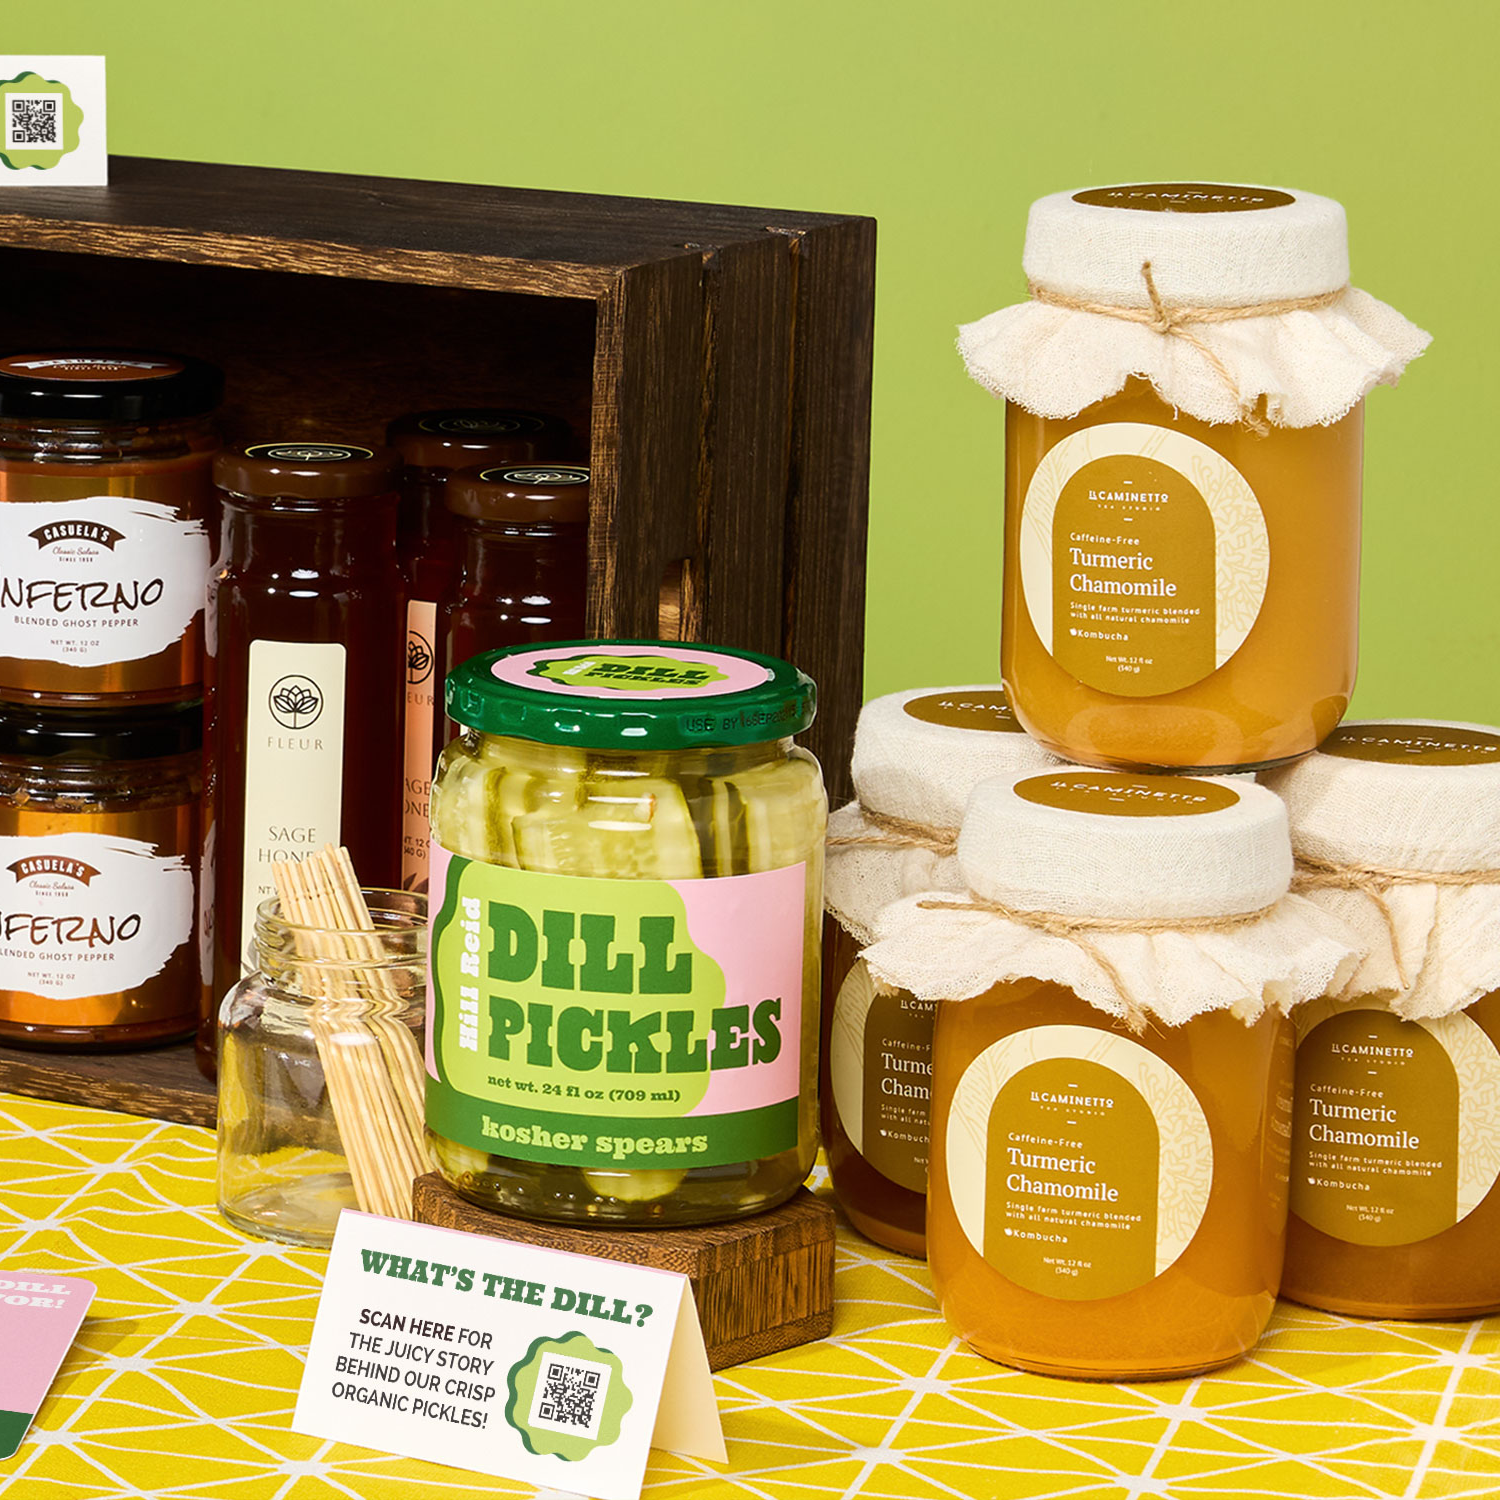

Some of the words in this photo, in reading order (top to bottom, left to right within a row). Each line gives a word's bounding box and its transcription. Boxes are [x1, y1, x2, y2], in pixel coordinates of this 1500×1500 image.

[43, 524, 110, 542] CASUELA'S
[1070, 532, 1140, 546] Caffeine-Free
[1069, 548, 1154, 570] Turmeric
[1070, 574, 1177, 597] Chamomile
[1070, 602, 1096, 612] Single
[1098, 604, 1118, 613] farm
[1121, 605, 1160, 615] turmeric
[1163, 606, 1200, 616] blended
[1070, 612, 1090, 620] with
[1106, 614, 1138, 624] natural
[1140, 616, 1190, 624] chamomile
[14, 615, 59, 627] BLENDED
[62, 618, 97, 627] GHOST
[102, 618, 139, 627] PEPPER
[1078, 630, 1129, 642] Kombucha
[592, 662, 710, 680] DILL
[686, 718, 715, 732] USE
[268, 736, 324, 750] FLEUR
[269, 826, 316, 844] SAGE
[20, 860, 85, 877] CASUELA'S
[460, 896, 482, 978] Reid
[488, 901, 693, 994] DILL
[39, 951, 72, 960] GHOST
[78, 953, 115, 961] PEPPER
[458, 985, 479, 1052] Hill
[488, 994, 782, 1074] PICKLES
[487, 1073, 514, 1090] net
[515, 1078, 538, 1094] wt.
[542, 1082, 562, 1096] 24
[566, 1083, 580, 1098] fl
[584, 1088, 604, 1100] oz
[608, 1088, 646, 1104] (709
[650, 1088, 681, 1104] ml)
[1310, 1084, 1384, 1098] Caffeine-Free
[1309, 1098, 1397, 1124] Turmeric
[481, 1115, 588, 1152] kosher
[595, 1132, 708, 1160] spears
[1008, 1132, 1084, 1148] Caffeine-Free
[1309, 1124, 1420, 1150] Chamomile
[1007, 1147, 1096, 1174] Turmeric
[1006, 1174, 1119, 1202] Chamomile
[1316, 1178, 1370, 1191] Kombucha
[1014, 1229, 1068, 1244] Kombucha
[360, 1248, 476, 1292] WHAT'S
[482, 1272, 546, 1307] THE
[550, 1286, 654, 1328] DILL?
[359, 1308, 407, 1332] SCAN
[408, 1318, 456, 1342] HERE
[458, 1328, 493, 1350] FOR
[349, 1332, 382, 1354] THE
[384, 1340, 436, 1366] JUICY
[437, 1350, 495, 1376] STORY
[335, 1356, 400, 1384] BEHIND
[403, 1370, 442, 1392] OUR
[444, 1378, 496, 1402] CRISP
[331, 1381, 409, 1412] ORGANIC
[412, 1398, 489, 1430] PICKLES!
